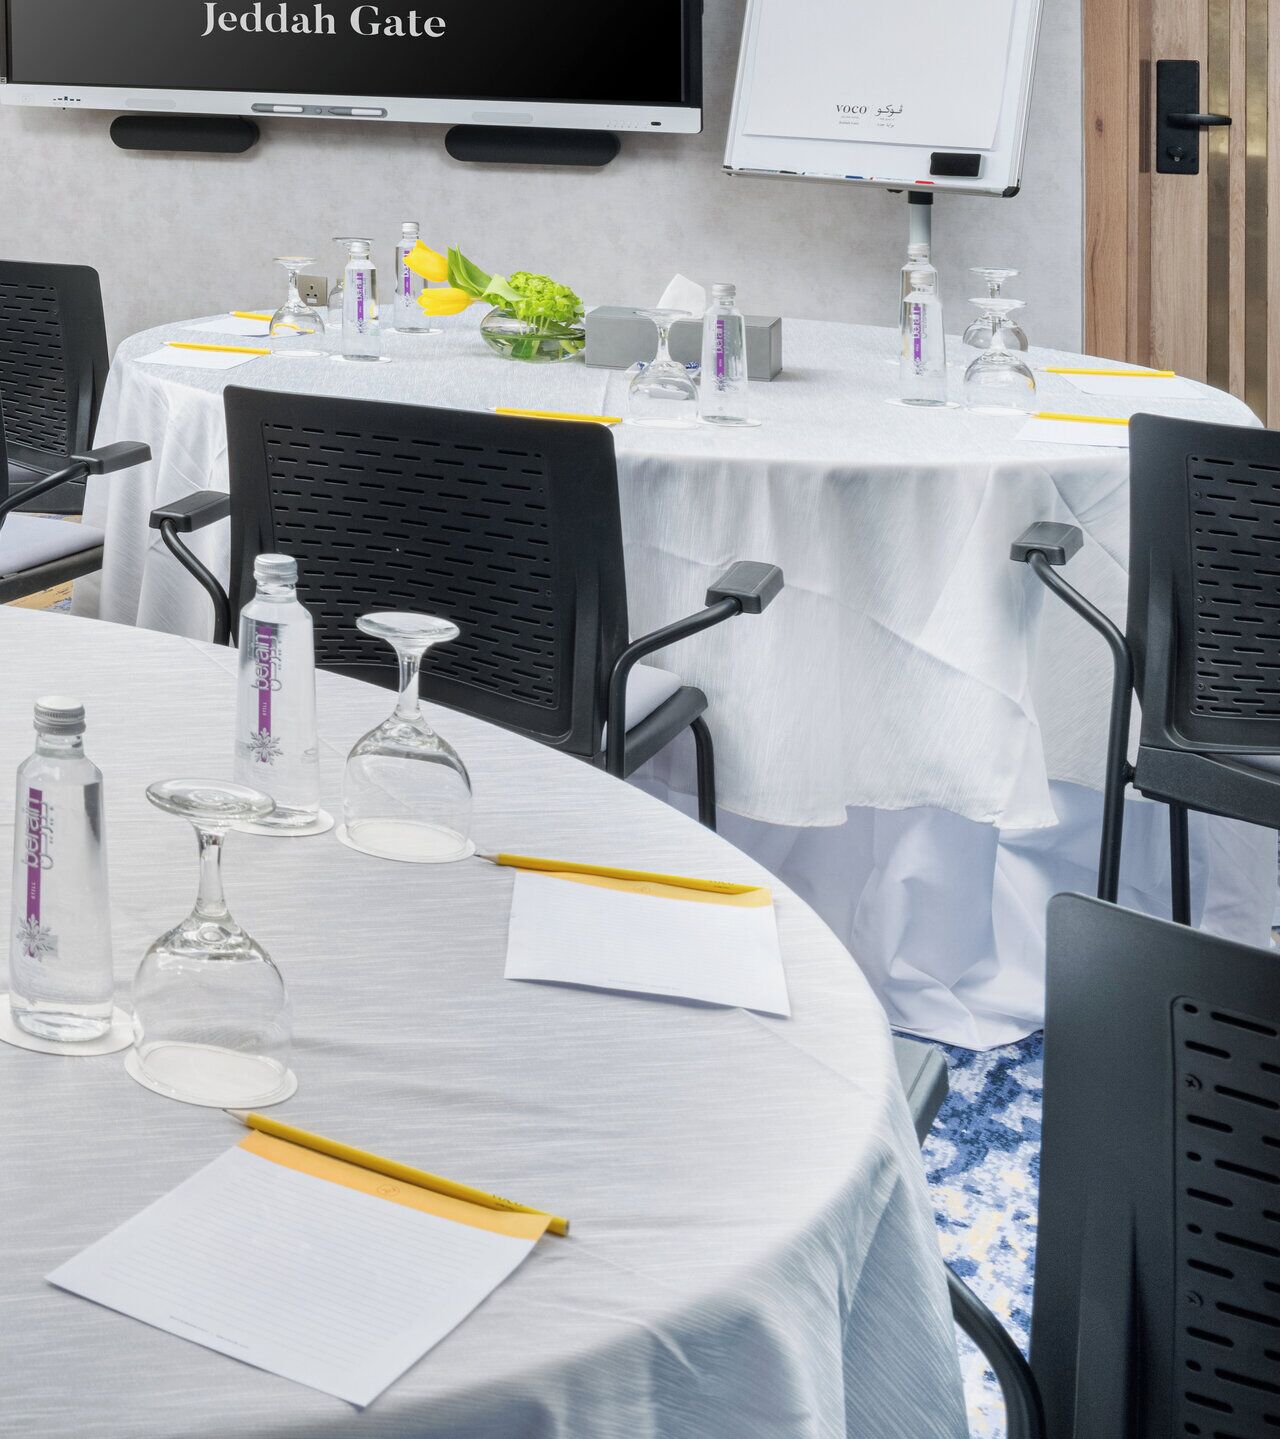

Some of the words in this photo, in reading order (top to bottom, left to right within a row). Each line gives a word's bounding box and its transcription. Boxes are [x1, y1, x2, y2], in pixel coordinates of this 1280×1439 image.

[200, 1, 337, 38] Jeddah
[350, 5, 447, 38] Gate
[251, 633, 270, 690] berain
[21, 797, 41, 869] berain
